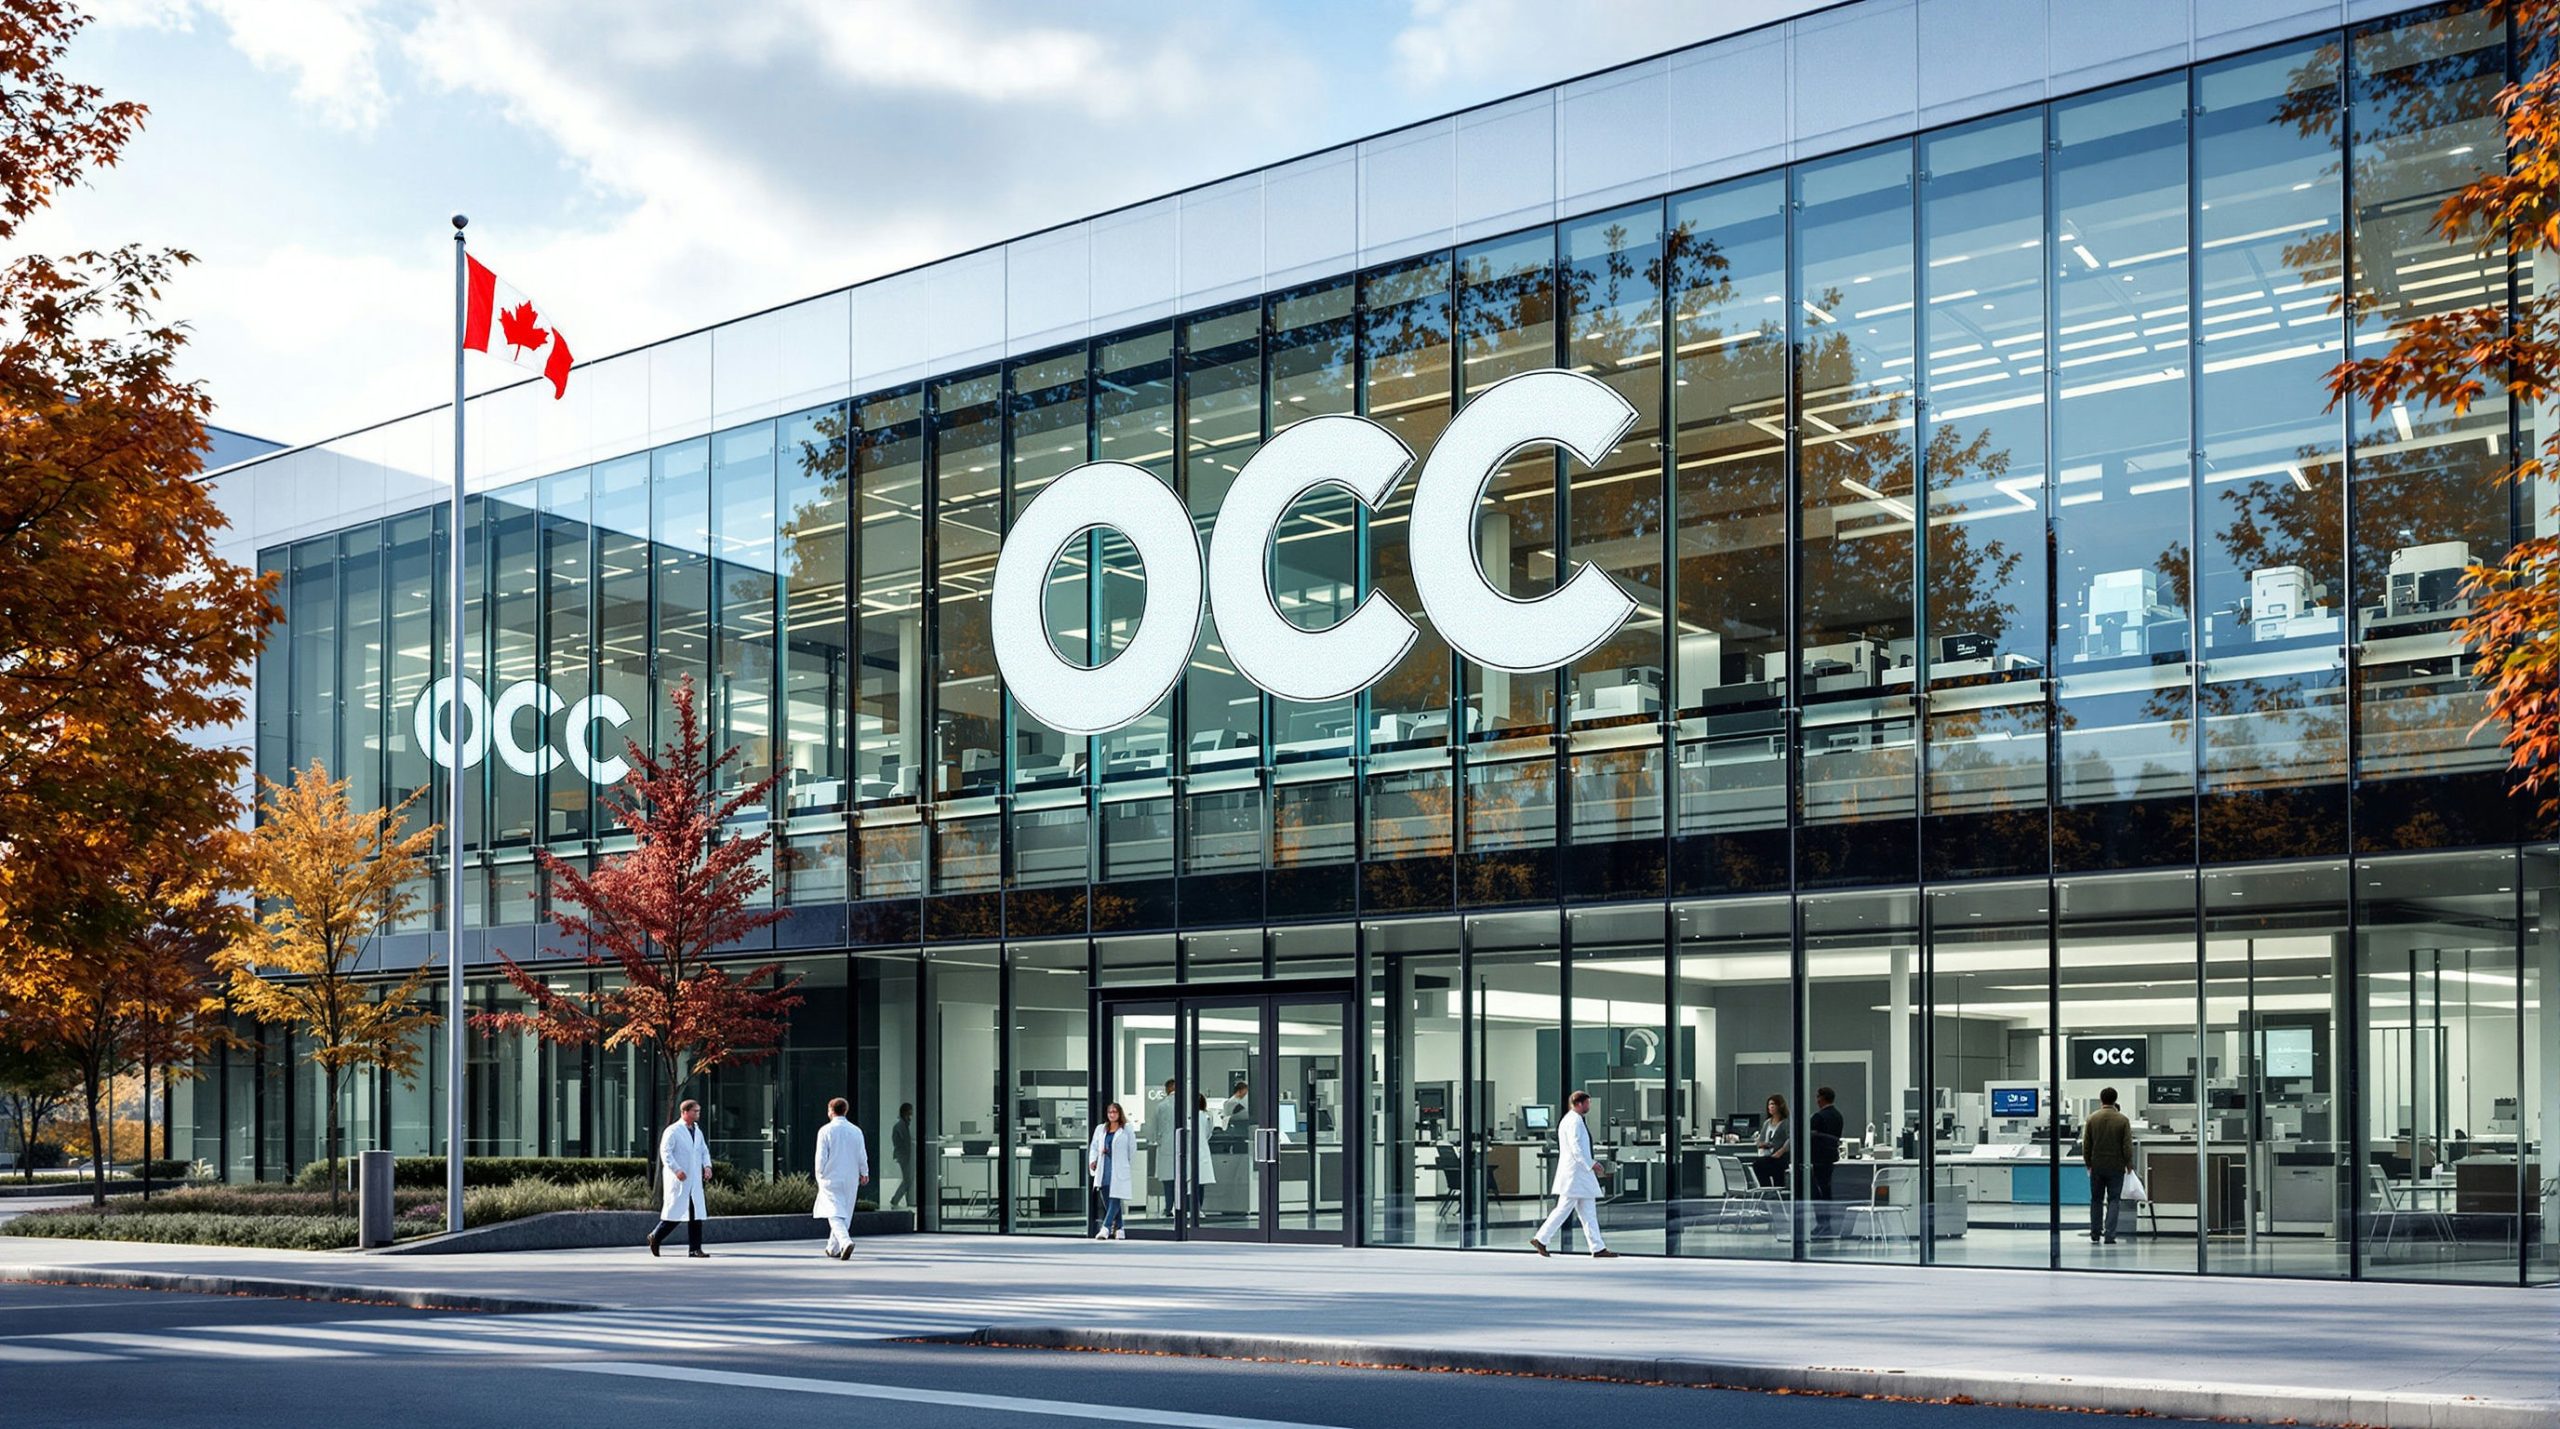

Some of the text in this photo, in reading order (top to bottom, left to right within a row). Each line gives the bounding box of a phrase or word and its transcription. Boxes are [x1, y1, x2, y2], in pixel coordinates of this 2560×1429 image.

[990, 368, 1640, 735] OCC
[413, 676, 632, 785] OCC
[2093, 1048, 2134, 1065] OCC
